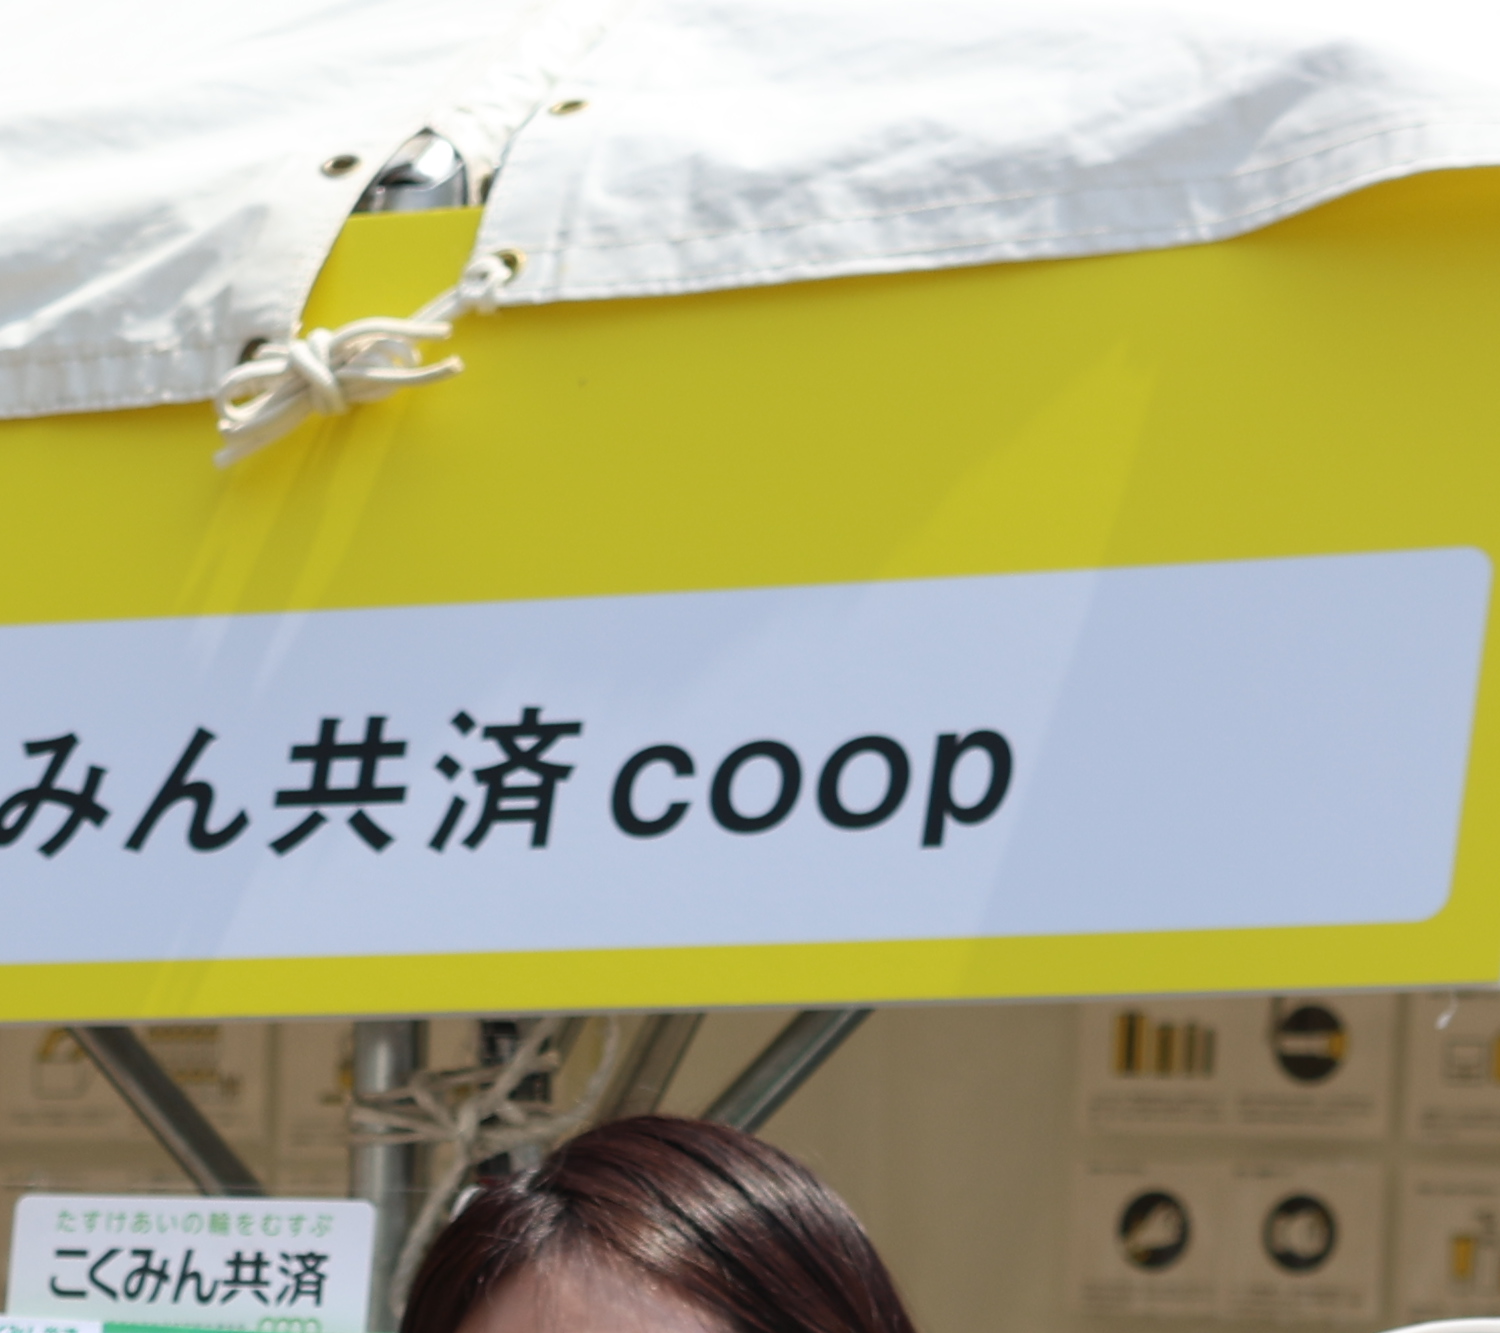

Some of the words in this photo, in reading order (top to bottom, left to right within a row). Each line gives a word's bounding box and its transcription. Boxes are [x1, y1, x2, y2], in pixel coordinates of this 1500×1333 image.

[56, 1208, 336, 1238] たすけあいの輪をむすぶ
[49, 1246, 330, 1307] こくみん共済
